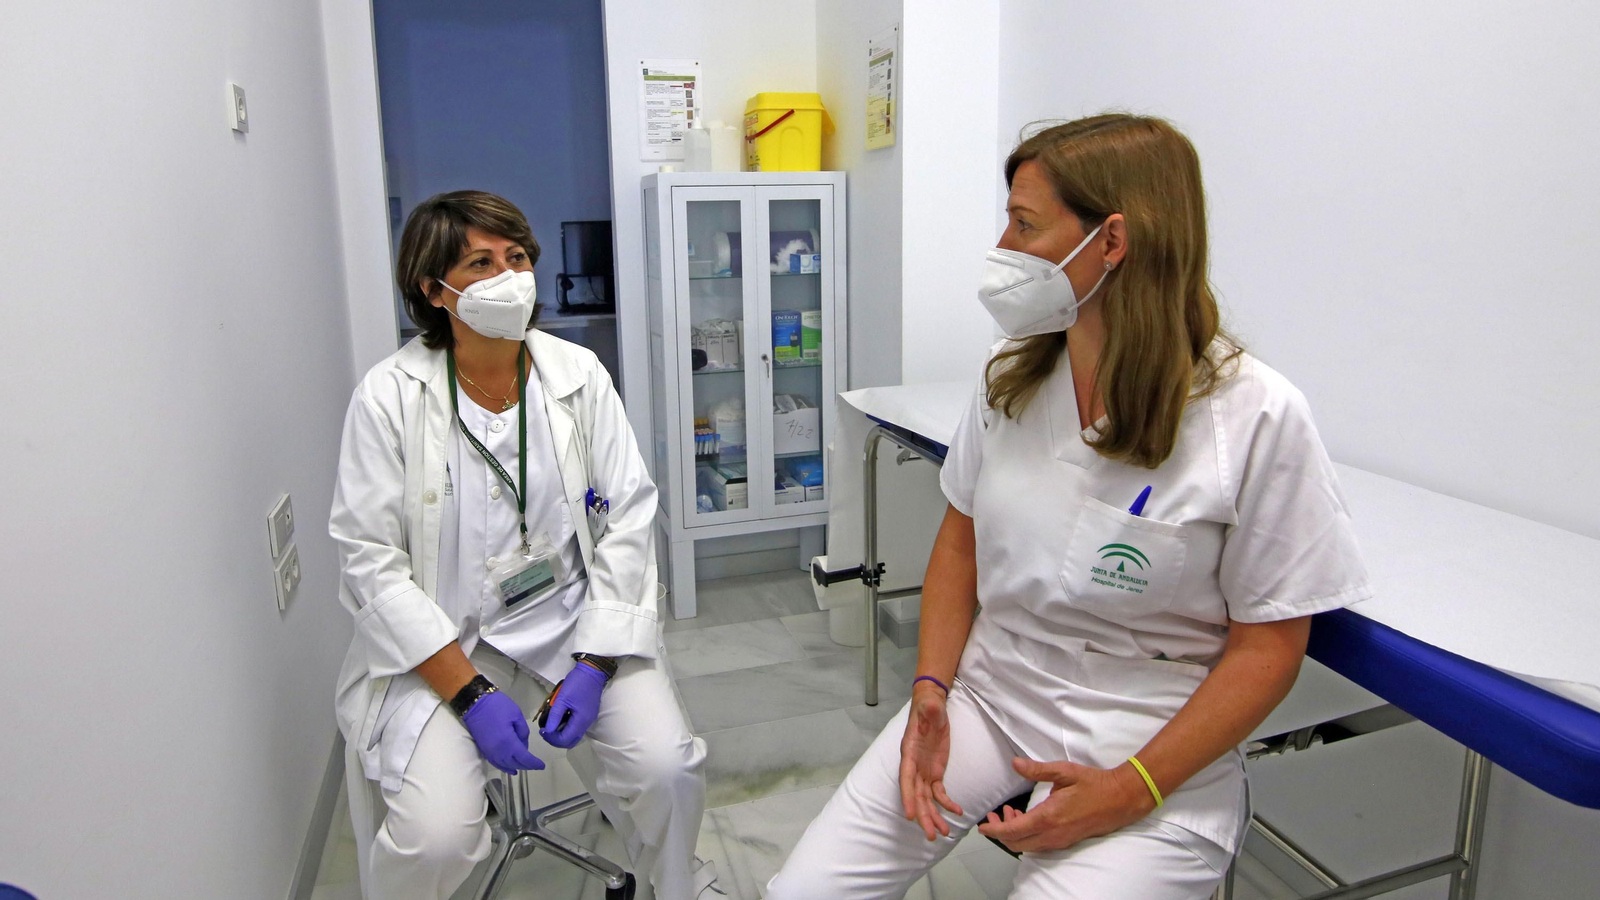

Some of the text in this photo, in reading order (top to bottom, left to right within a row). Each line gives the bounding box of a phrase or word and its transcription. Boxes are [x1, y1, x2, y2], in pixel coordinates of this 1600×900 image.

[1090, 566, 1107, 576] JUNTA
[1091, 576, 1116, 587] Hospital
[1126, 585, 1143, 593] Jerez
